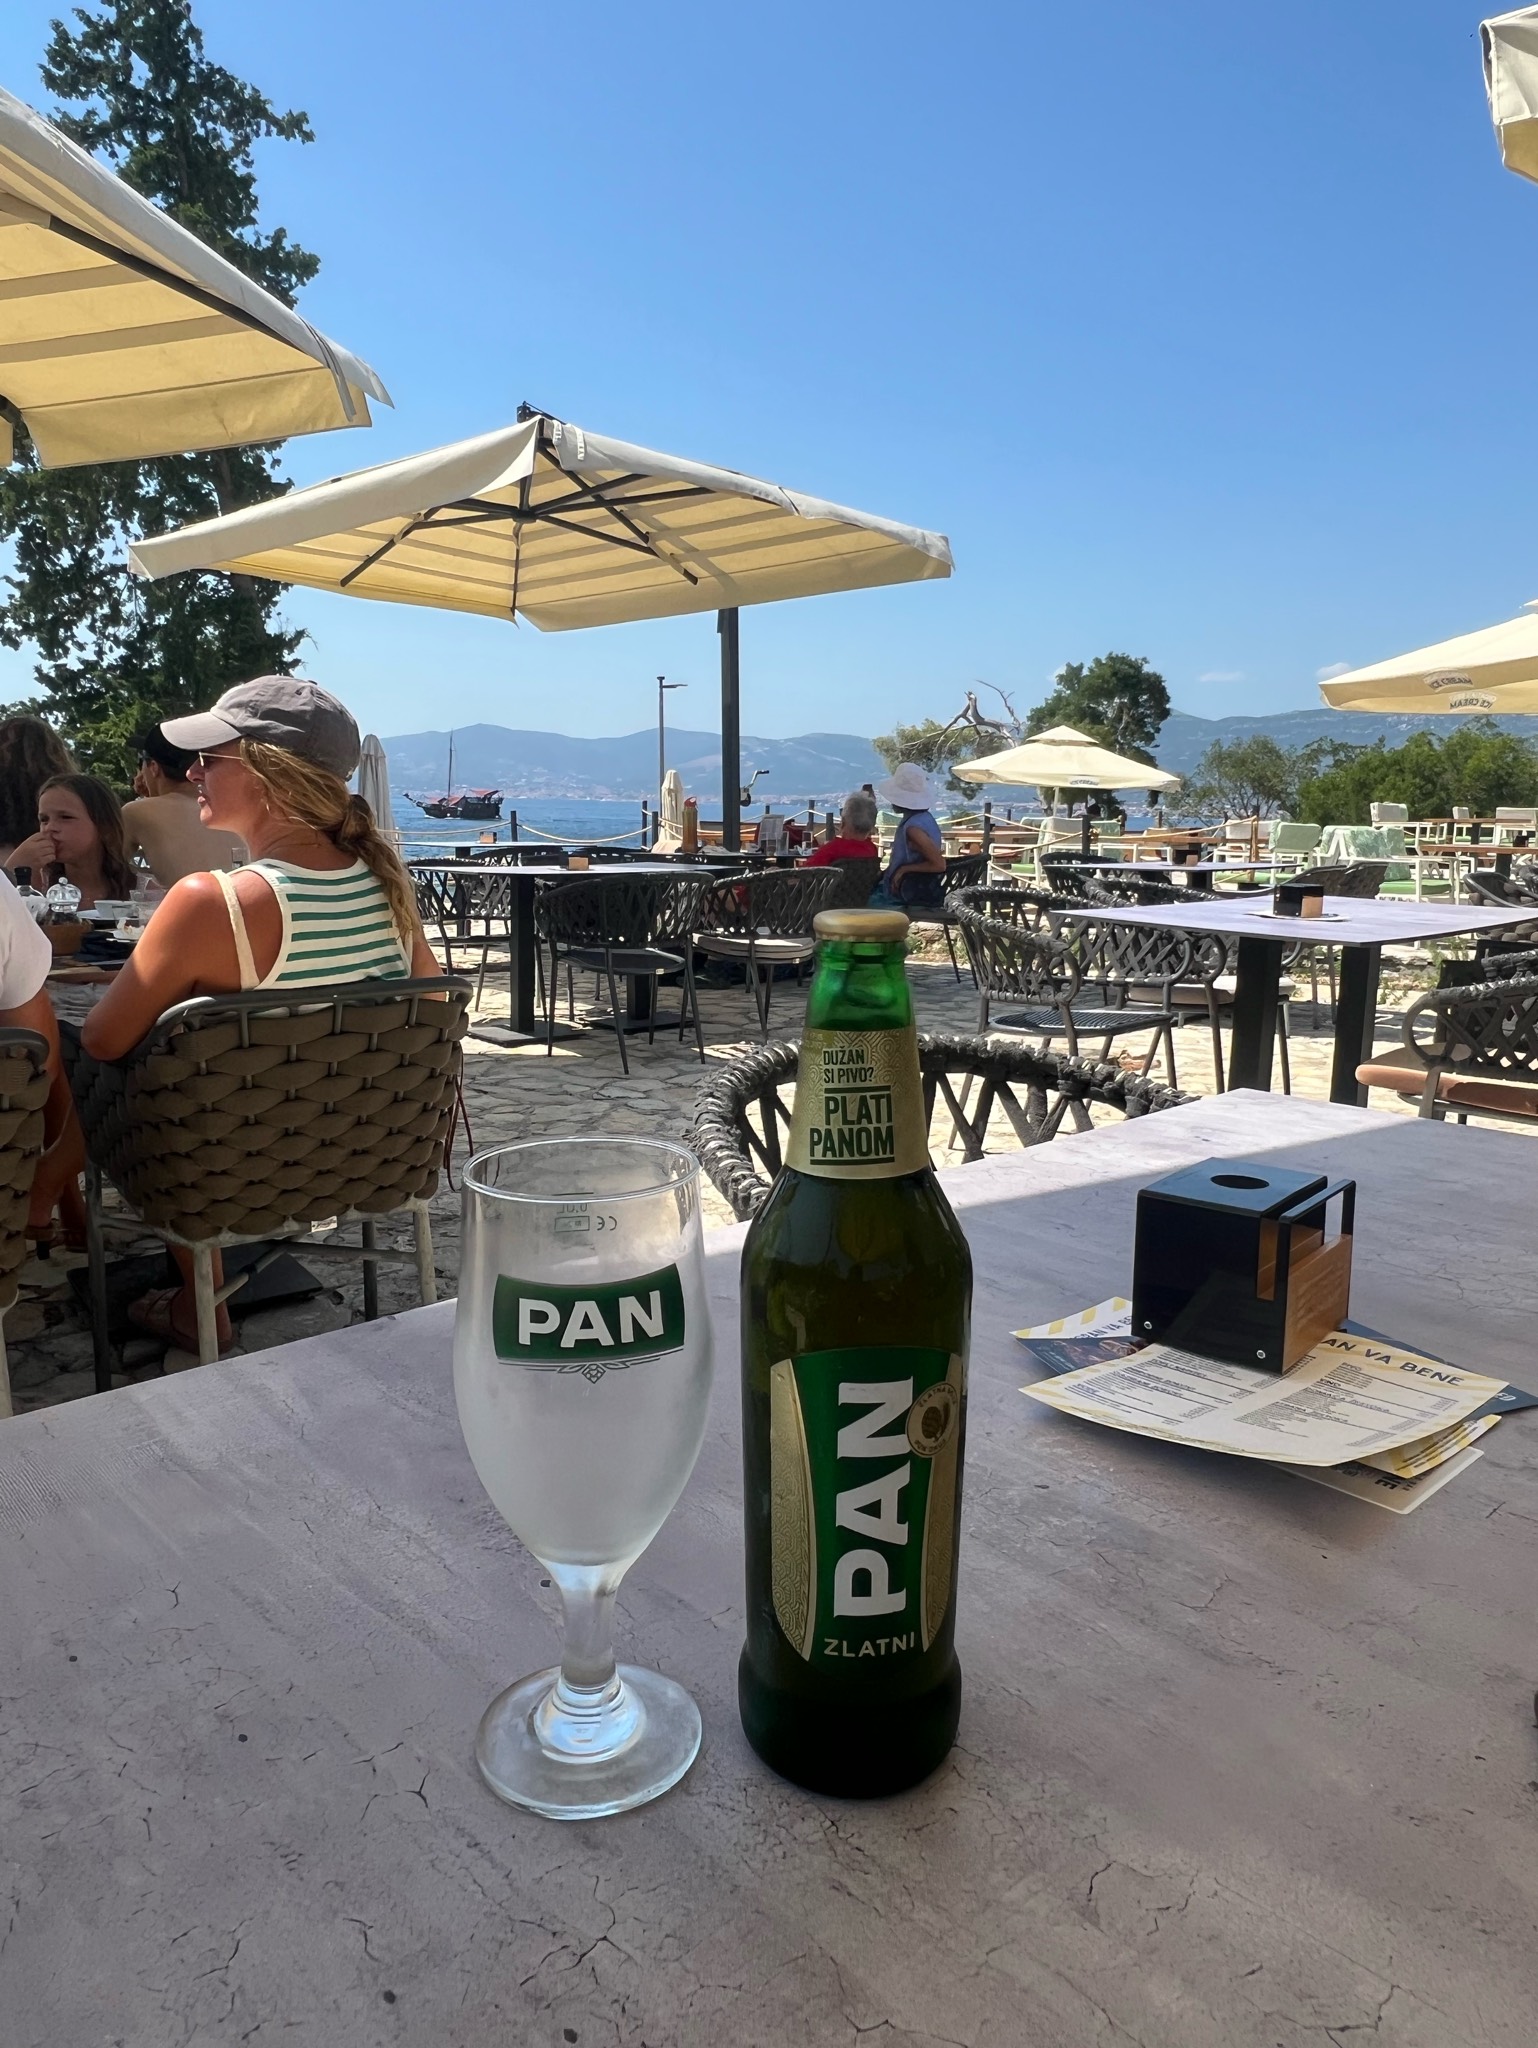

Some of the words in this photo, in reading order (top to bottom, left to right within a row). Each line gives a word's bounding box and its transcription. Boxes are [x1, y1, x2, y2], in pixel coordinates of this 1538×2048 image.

[823, 1046, 865, 1066] DUŽAN
[823, 1068, 835, 1084] SI
[838, 1067, 875, 1084] PIVO?
[825, 1093, 893, 1126] PLATI
[809, 1126, 895, 1158] PANOM
[518, 1290, 665, 1348] PAN
[1320, 1338, 1357, 1351] AN
[1364, 1348, 1392, 1364] VA
[1400, 1362, 1465, 1386] BENE
[833, 1375, 914, 1618] PAN
[824, 1631, 915, 1658] ZLATNI
